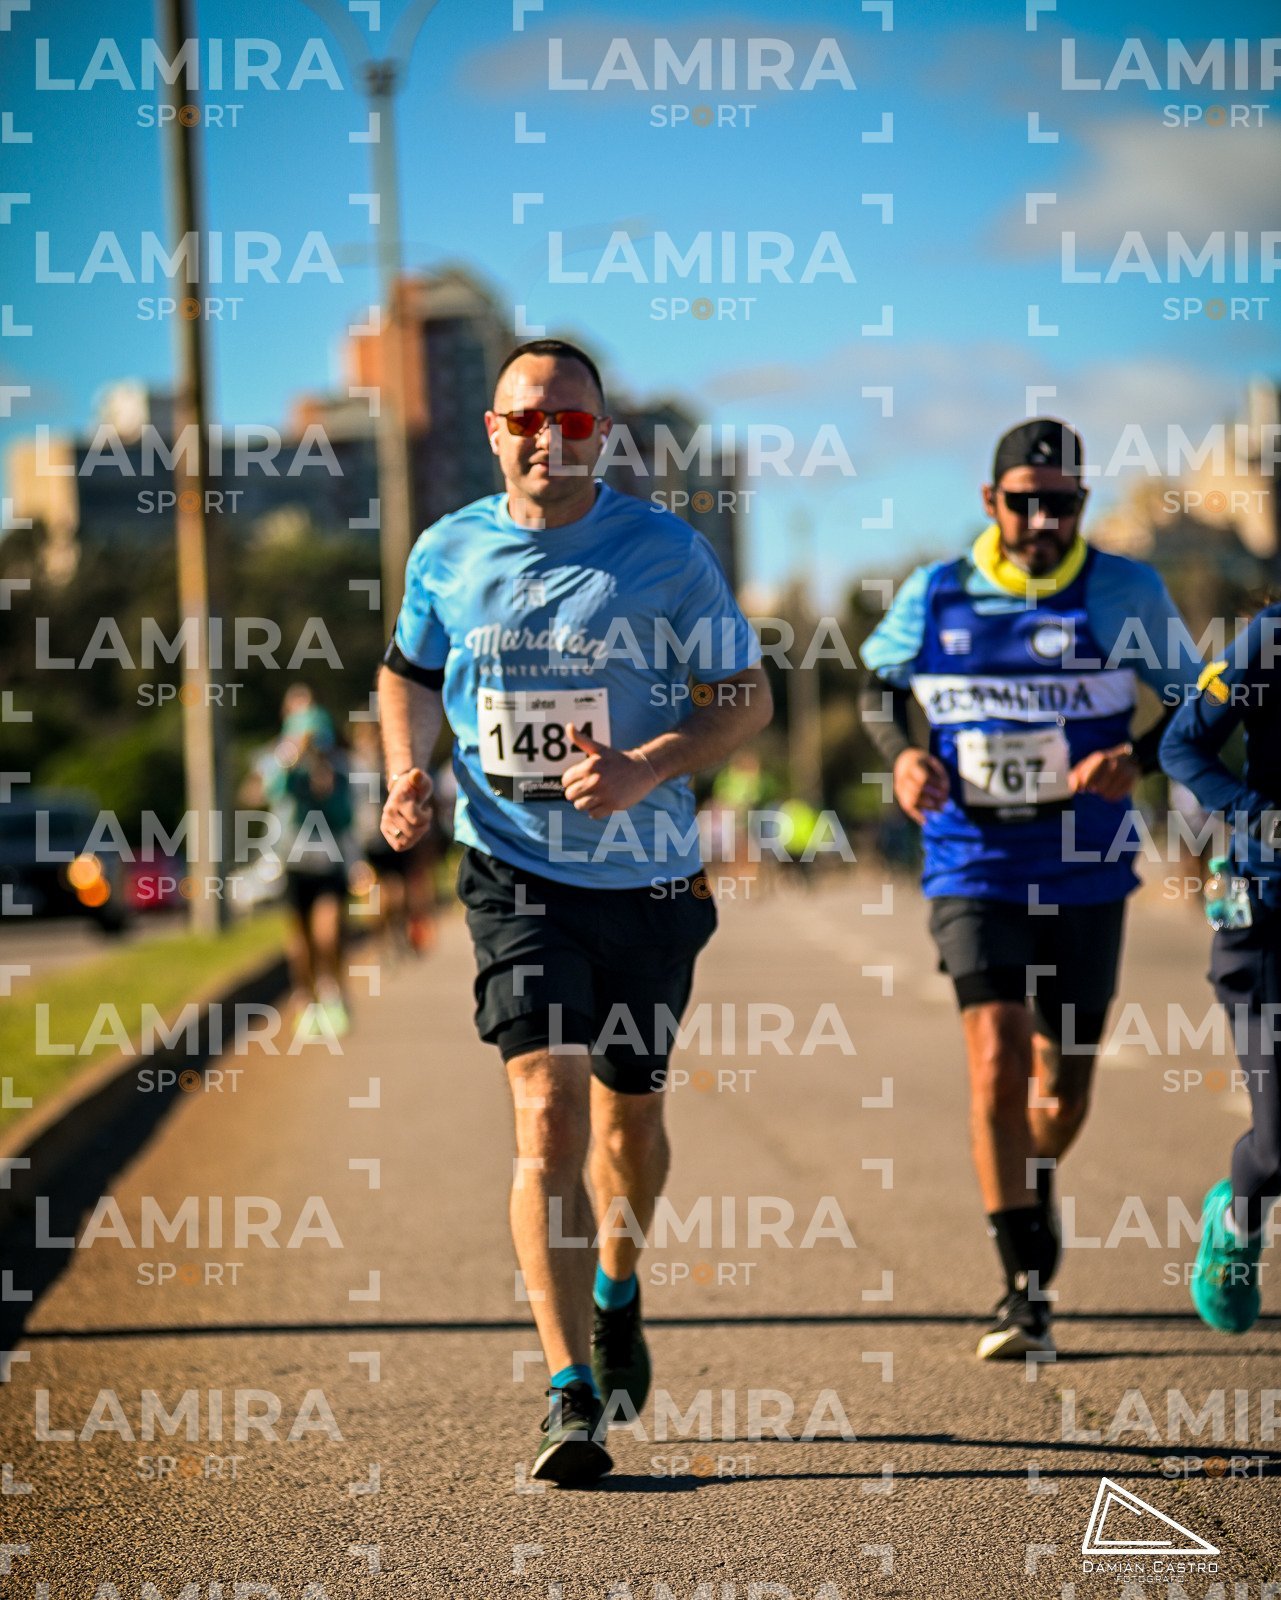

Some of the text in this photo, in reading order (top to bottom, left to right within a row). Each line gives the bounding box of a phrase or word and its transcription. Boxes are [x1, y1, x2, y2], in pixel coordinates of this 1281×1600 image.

[464, 623, 608, 660] Maratón
[489, 722, 594, 763] 1484
[981, 758, 1046, 793] 767
